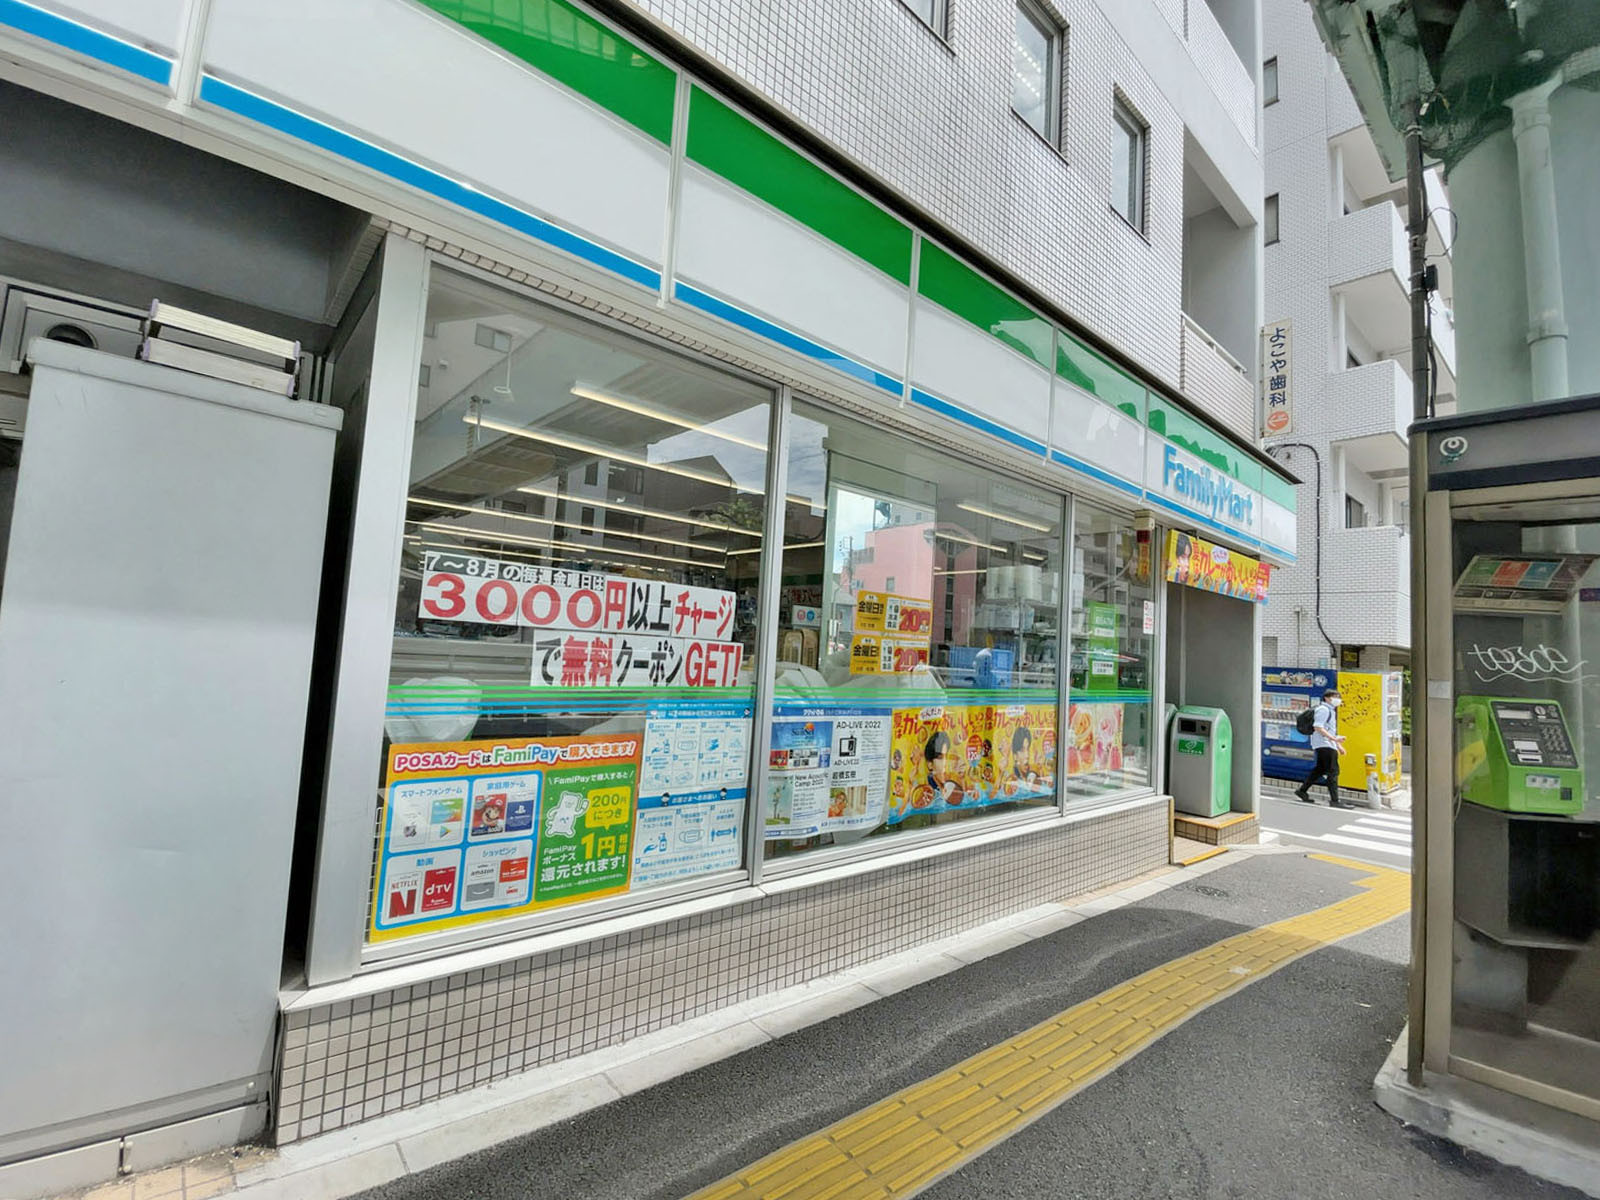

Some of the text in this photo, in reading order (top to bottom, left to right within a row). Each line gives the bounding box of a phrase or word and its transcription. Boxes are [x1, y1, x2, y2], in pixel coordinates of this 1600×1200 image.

[1269, 327, 1287, 407] よこや歯科
[1164, 443, 1253, 526] FamilyMart
[423, 572, 733, 638] 3000円以上チャージ
[593, 808, 622, 821] につき
[543, 845, 577, 855] FamiPay
[542, 852, 577, 866] ボーナス
[540, 855, 627, 883] 還元されます!
[391, 879, 418, 890] NETFLIX
[425, 883, 452, 896] dTV
